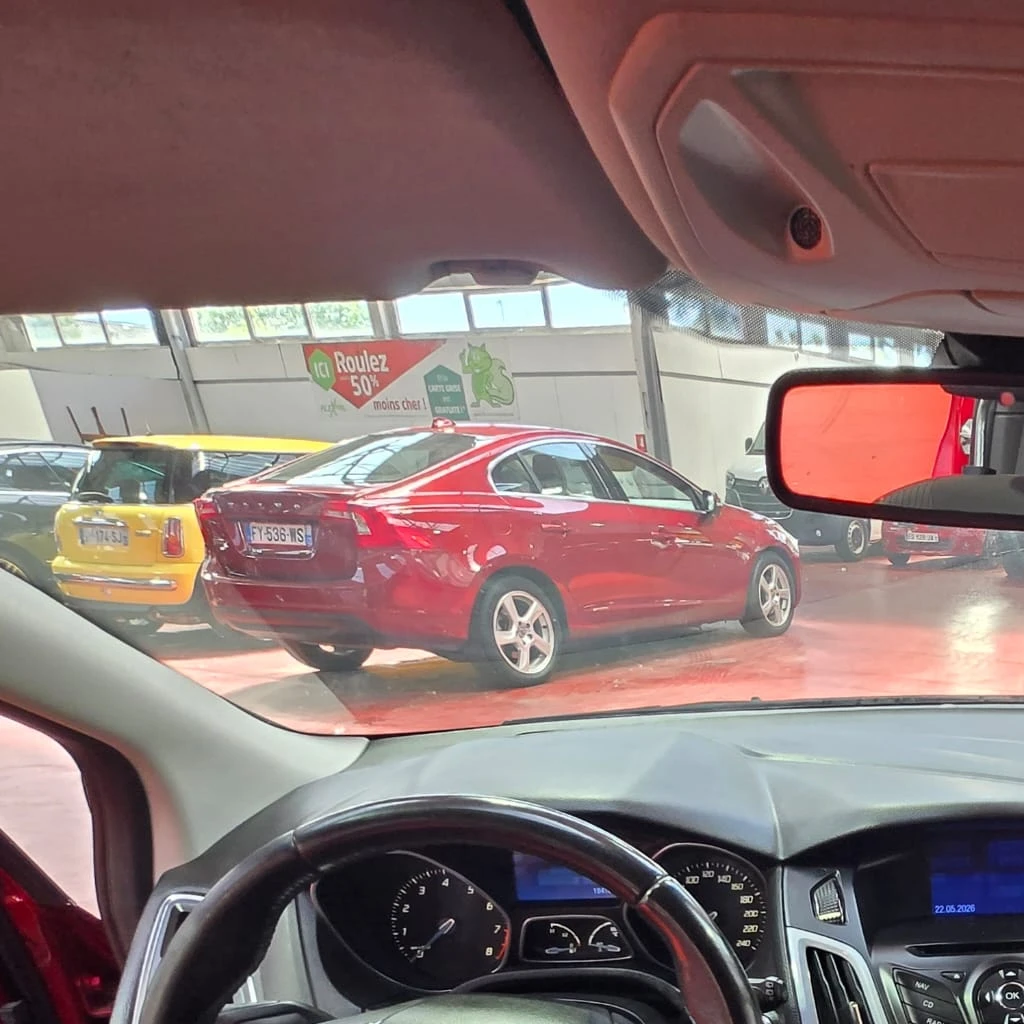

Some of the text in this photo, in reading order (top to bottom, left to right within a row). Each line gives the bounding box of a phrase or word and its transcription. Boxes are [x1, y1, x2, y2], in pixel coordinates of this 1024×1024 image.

[334, 350, 390, 373] Roulez
[313, 362, 330, 378] ICI
[350, 374, 380, 396] 50%
[373, 397, 400, 411] moins
[402, 397, 421, 410] cher
[702, 870, 715, 878] 120
[442, 878, 450, 888] 4
[685, 876, 700, 884] 100
[718, 875, 732, 883] 140
[419, 886, 426, 895] 3
[402, 904, 410, 913] 2
[486, 902, 494, 910] 6
[935, 904, 976, 914] 22.05.2026
[744, 910, 758, 918] 200
[402, 928, 407, 936] 1
[494, 925, 502, 934] 7
[743, 925, 758, 933] 220
[486, 948, 493, 956] 8
[915, 981, 930, 990] NAV
[1005, 992, 1020, 1000] OK
[922, 1000, 934, 1009] CD
